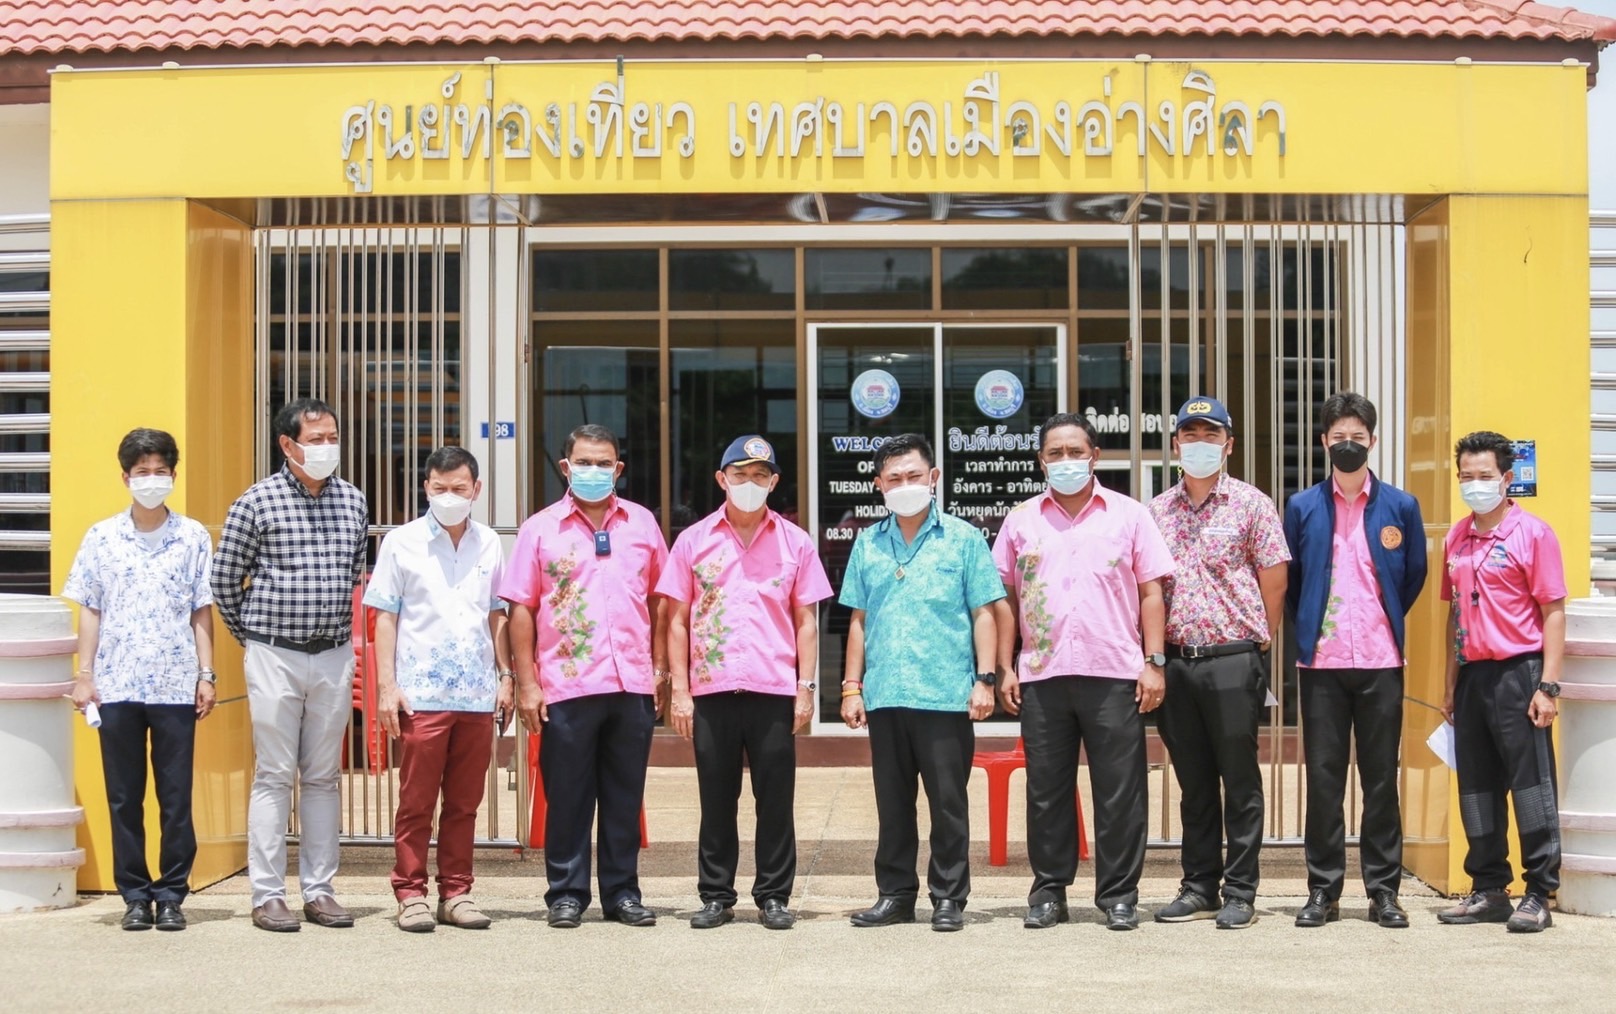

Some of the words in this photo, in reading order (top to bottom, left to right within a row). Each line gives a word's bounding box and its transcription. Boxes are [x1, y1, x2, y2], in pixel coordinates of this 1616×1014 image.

[341, 55, 696, 194] ศูนย์ท่องเที่ยว
[727, 71, 1287, 159] เทศบาลเมืองอ่างศิลา
[965, 456, 1034, 472] เวลาทำการ
[829, 481, 874, 494] TUESDAY
[953, 478, 992, 493] อังคาร
[826, 527, 854, 540] 08.30
